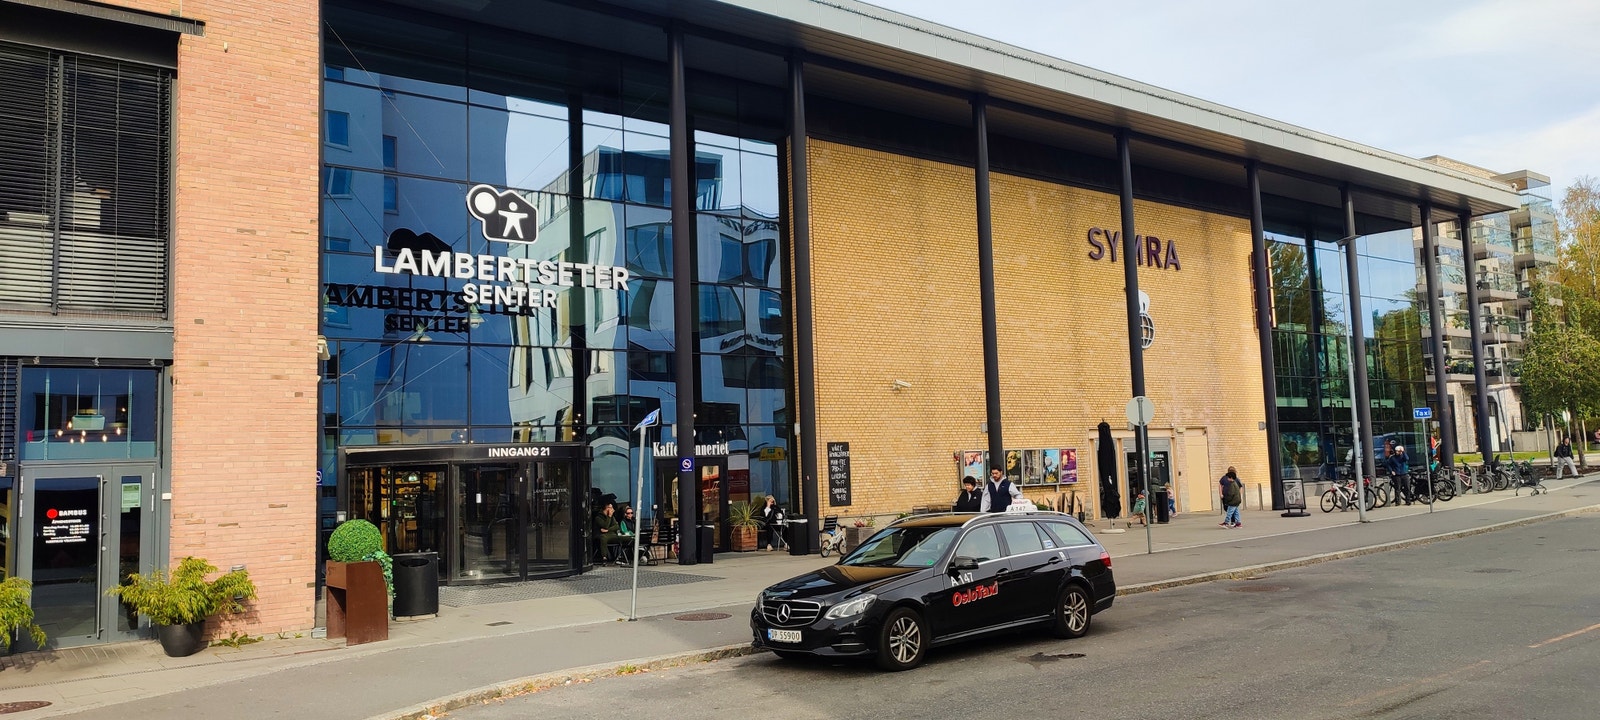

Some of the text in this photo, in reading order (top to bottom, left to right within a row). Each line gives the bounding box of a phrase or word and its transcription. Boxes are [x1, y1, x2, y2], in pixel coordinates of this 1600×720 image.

[374, 245, 629, 291] LAMBERTSETER
[462, 282, 557, 309] SENTER
[488, 446, 550, 457] INNGANG 21
[653, 441, 729, 457] Kaffenneriet
[58, 509, 87, 517] BAMBUS
[950, 572, 974, 587] A 147
[952, 580, 999, 607] OsloTaxi
